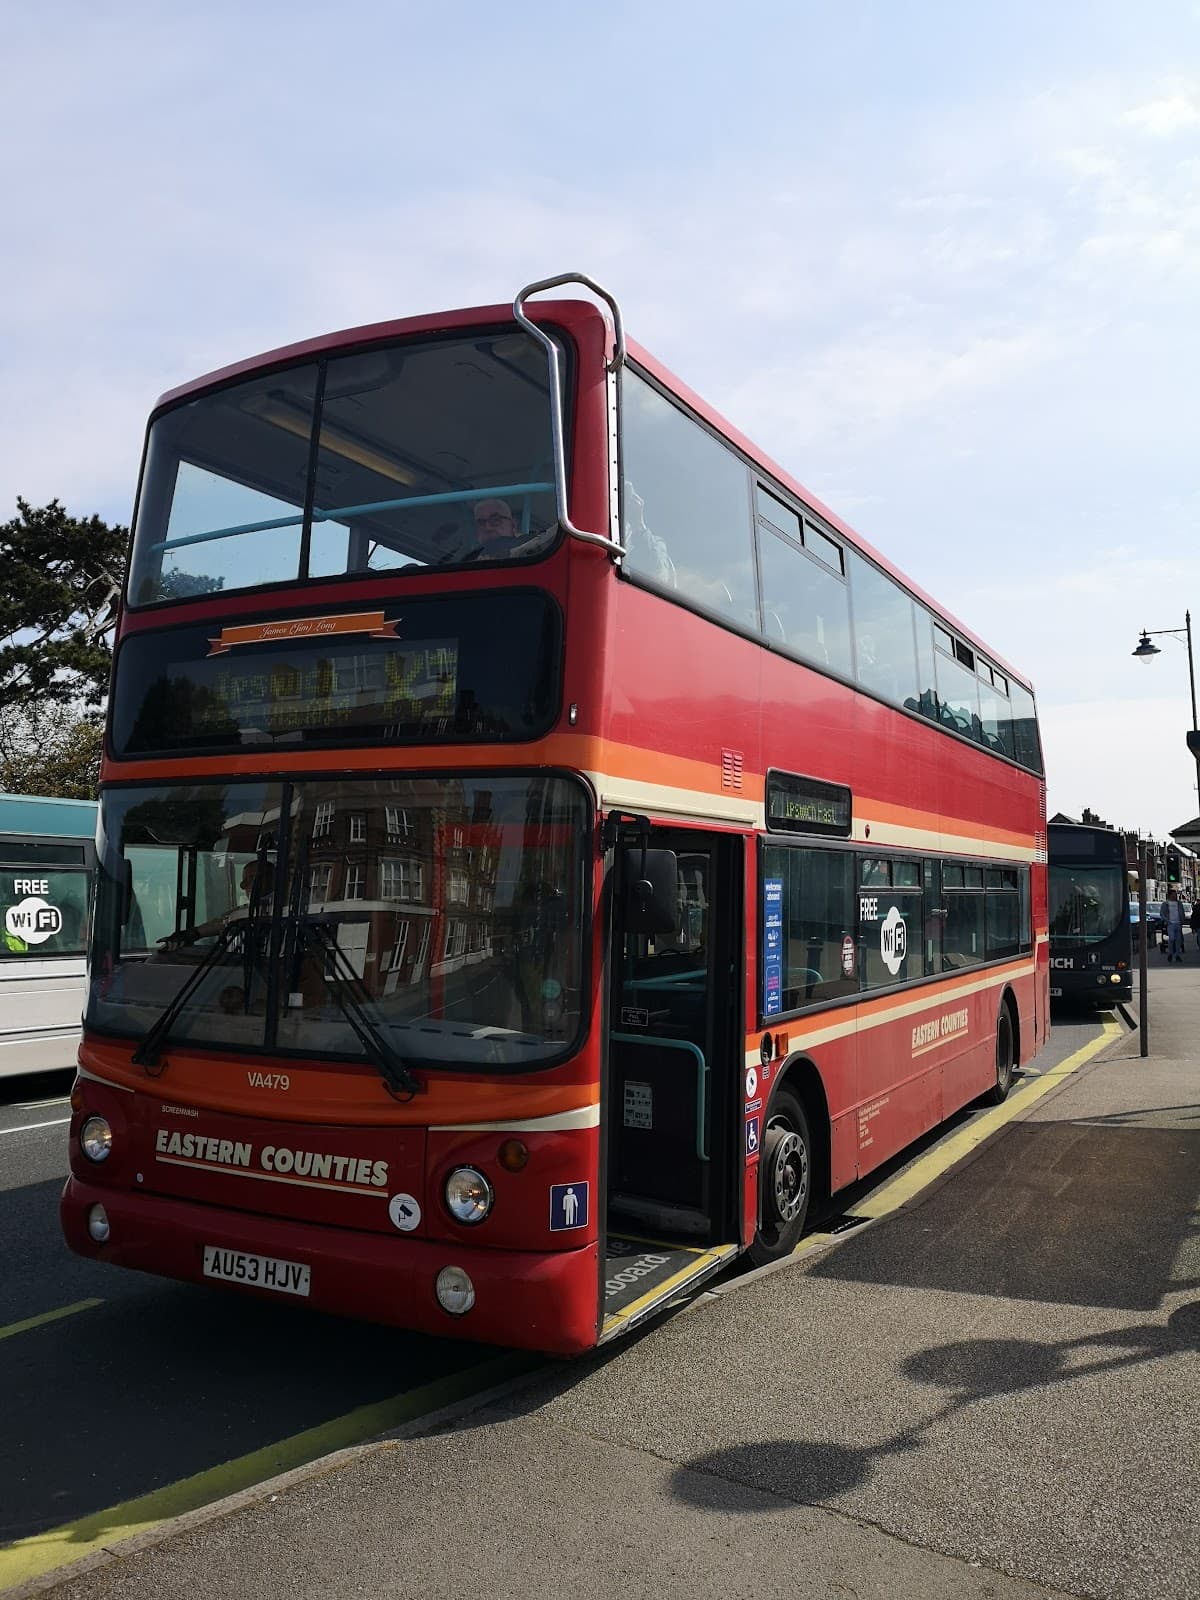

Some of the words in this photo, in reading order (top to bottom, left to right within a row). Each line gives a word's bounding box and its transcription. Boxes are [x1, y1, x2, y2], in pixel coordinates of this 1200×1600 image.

[14, 879, 49, 895] FREE
[860, 897, 878, 921] FREE
[912, 1018, 940, 1050] EASTERN
[941, 1007, 968, 1036] COUNTIES
[247, 1071, 290, 1091] VA479
[161, 1104, 199, 1117] SCREENWASH
[156, 1129, 252, 1167] EASTERN
[260, 1145, 389, 1187] COUNTIES
[210, 1250, 260, 1281] AU53
[264, 1261, 303, 1290] HJV
